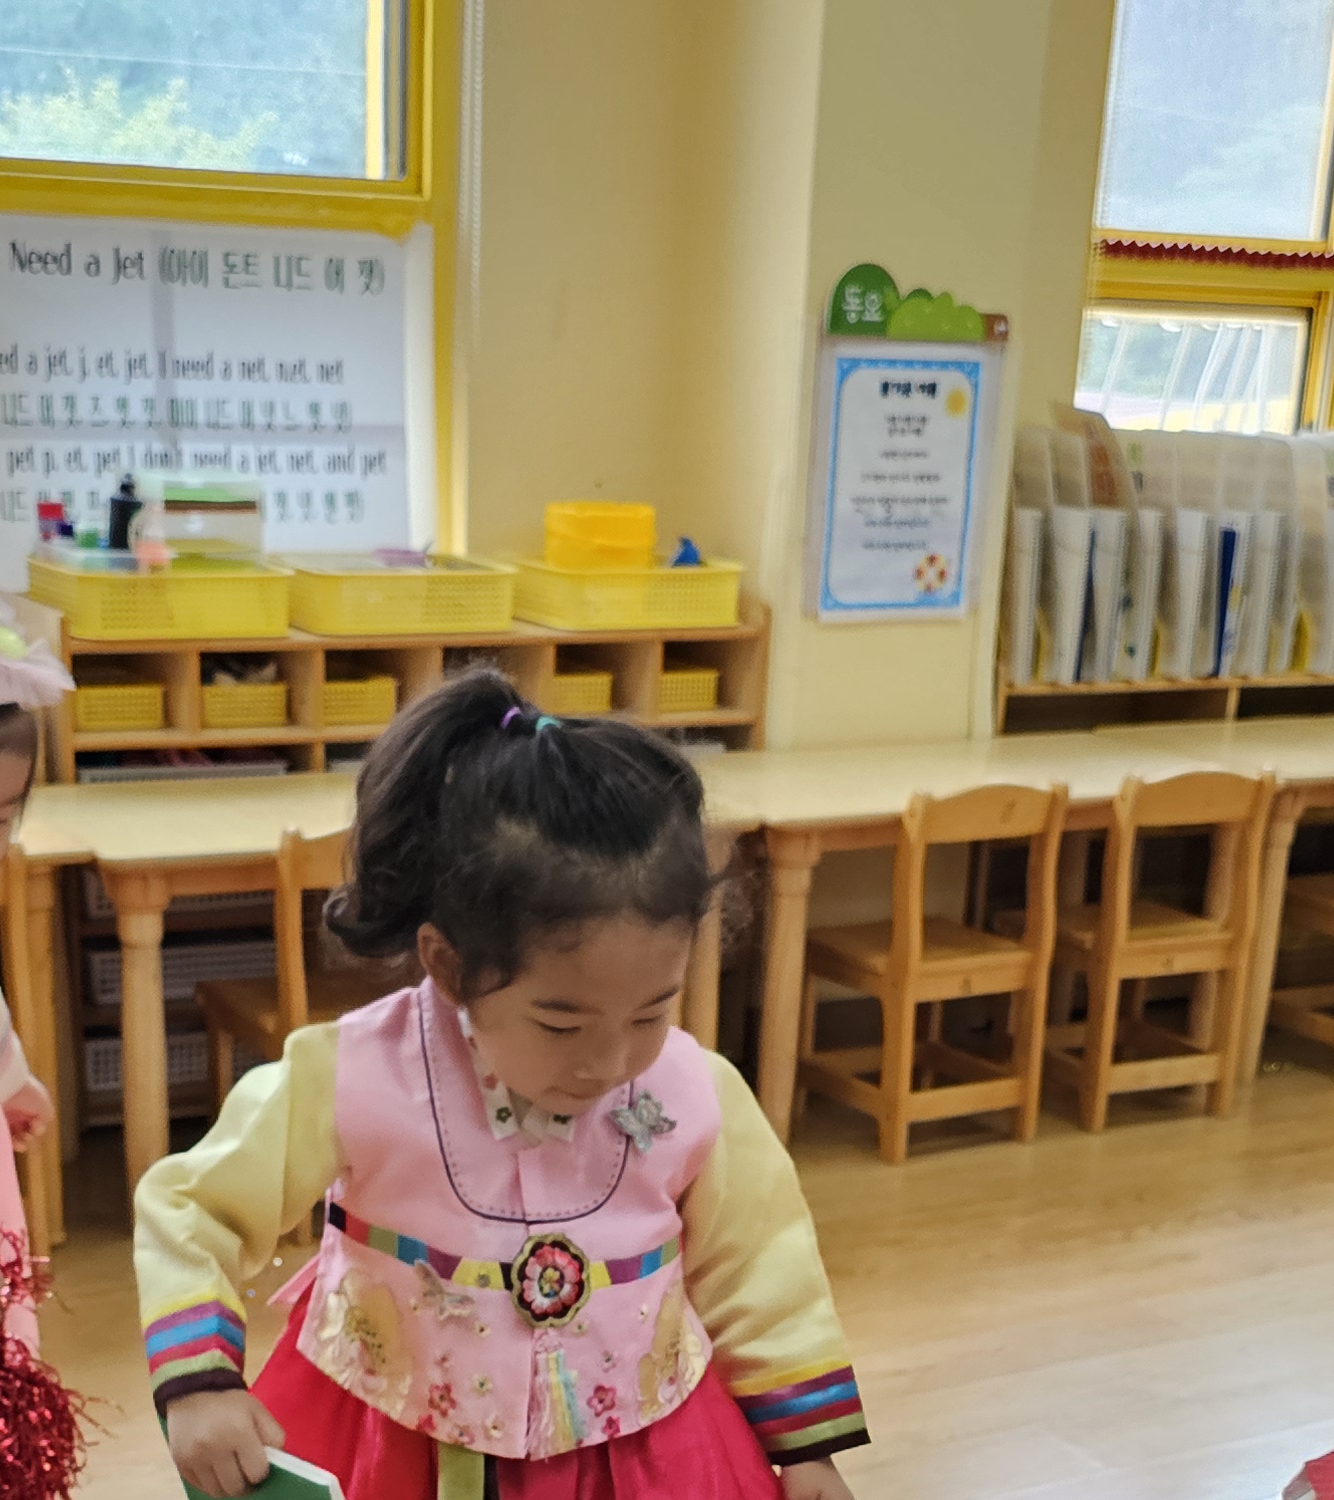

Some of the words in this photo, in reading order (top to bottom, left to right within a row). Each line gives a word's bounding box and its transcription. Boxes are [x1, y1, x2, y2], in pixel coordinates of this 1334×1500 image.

[9, 241, 73, 277] Need
[84, 254, 101, 278] a
[111, 246, 145, 285] Jet
